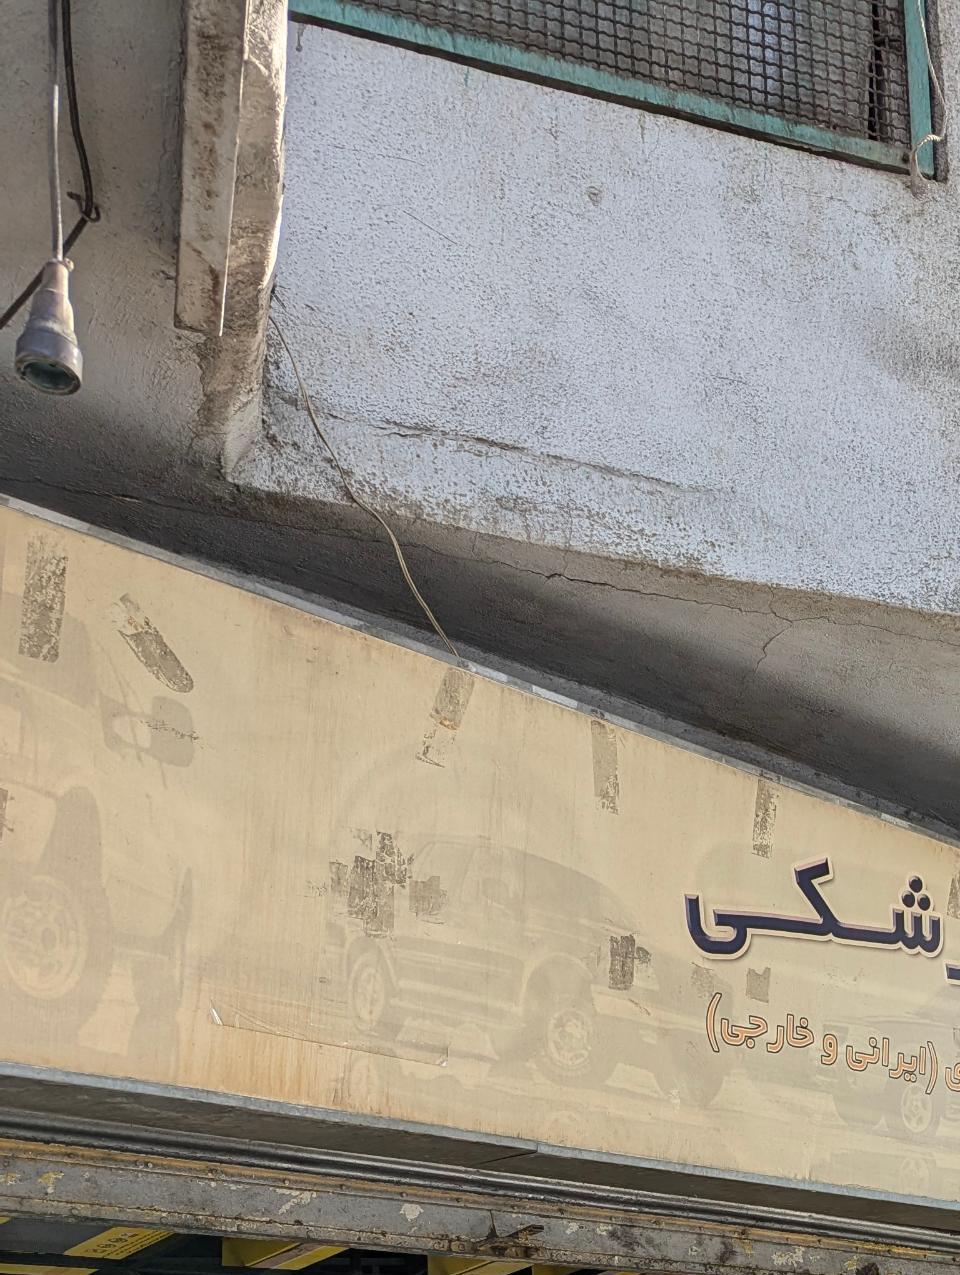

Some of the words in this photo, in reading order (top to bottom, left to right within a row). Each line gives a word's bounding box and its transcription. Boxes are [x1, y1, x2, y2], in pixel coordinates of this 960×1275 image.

[706, 992, 815, 1054] خارجی)
[820, 1033, 838, 1066] و
[846, 1035, 939, 1096] (ایرانی
